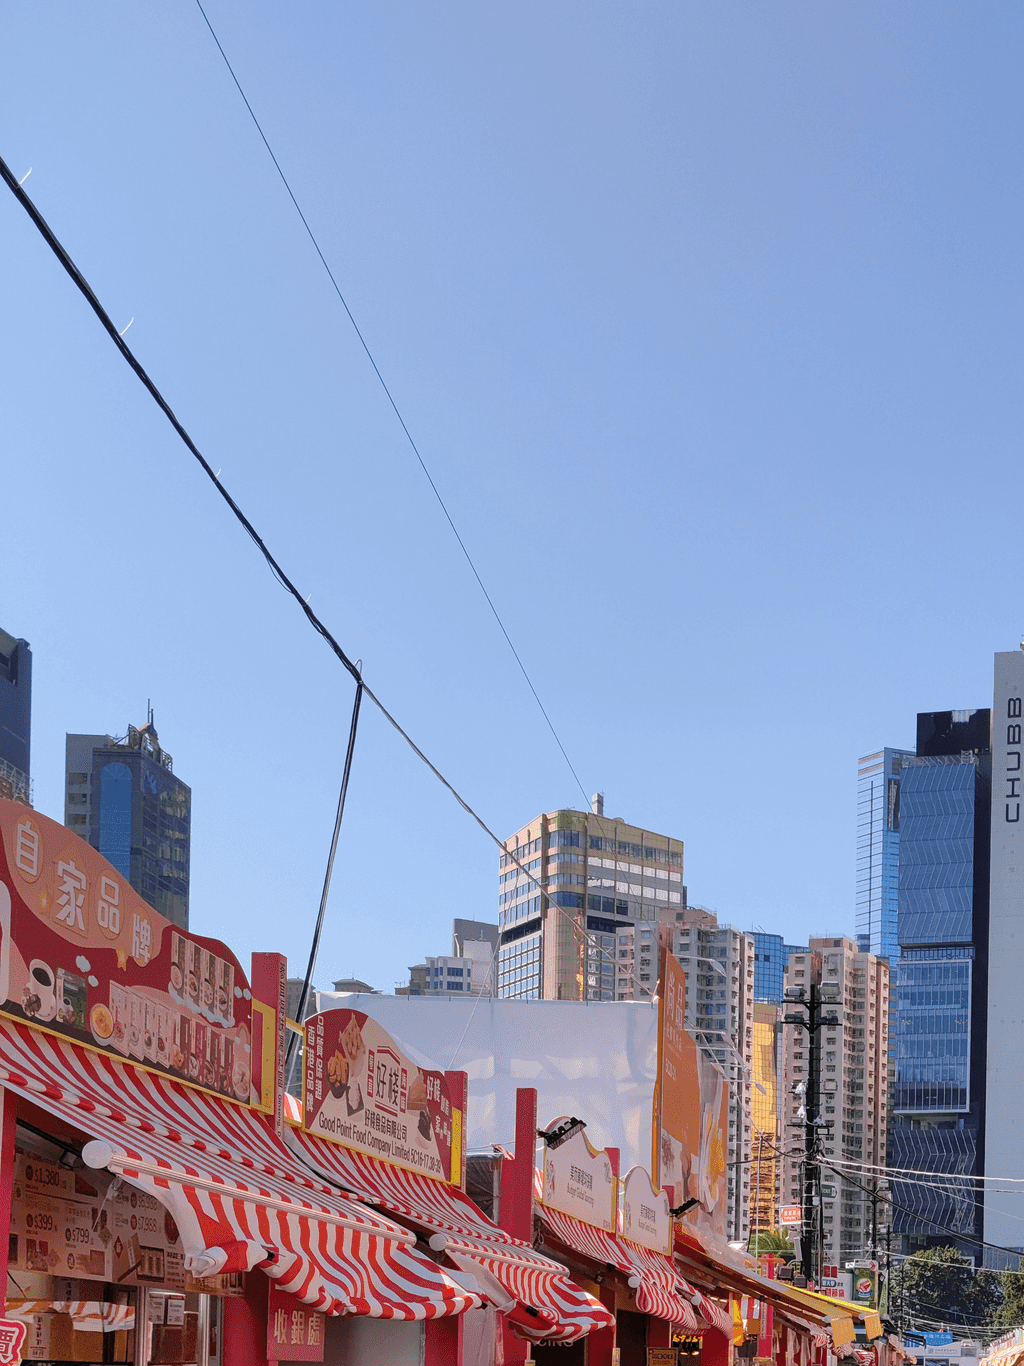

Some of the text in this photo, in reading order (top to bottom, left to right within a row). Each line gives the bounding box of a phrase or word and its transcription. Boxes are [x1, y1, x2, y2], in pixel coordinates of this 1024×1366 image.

[1005, 697, 1022, 823] CHUBB
[16, 820, 151, 963] 自家品牌
[375, 1060, 399, 1106] 好棧
[318, 1111, 335, 1135] Good
[336, 1117, 352, 1140] Point
[352, 1122, 367, 1145] Food
[367, 1130, 391, 1157] Company
[391, 1142, 410, 1162] Limited
[364, 1107, 407, 1143] 好棧食品有限公司
[34, 1168, 60, 1187] $1,380
[34, 1214, 53, 1231] $399
[71, 1227, 90, 1244] $799
[273, 1308, 321, 1346] 收銀處
